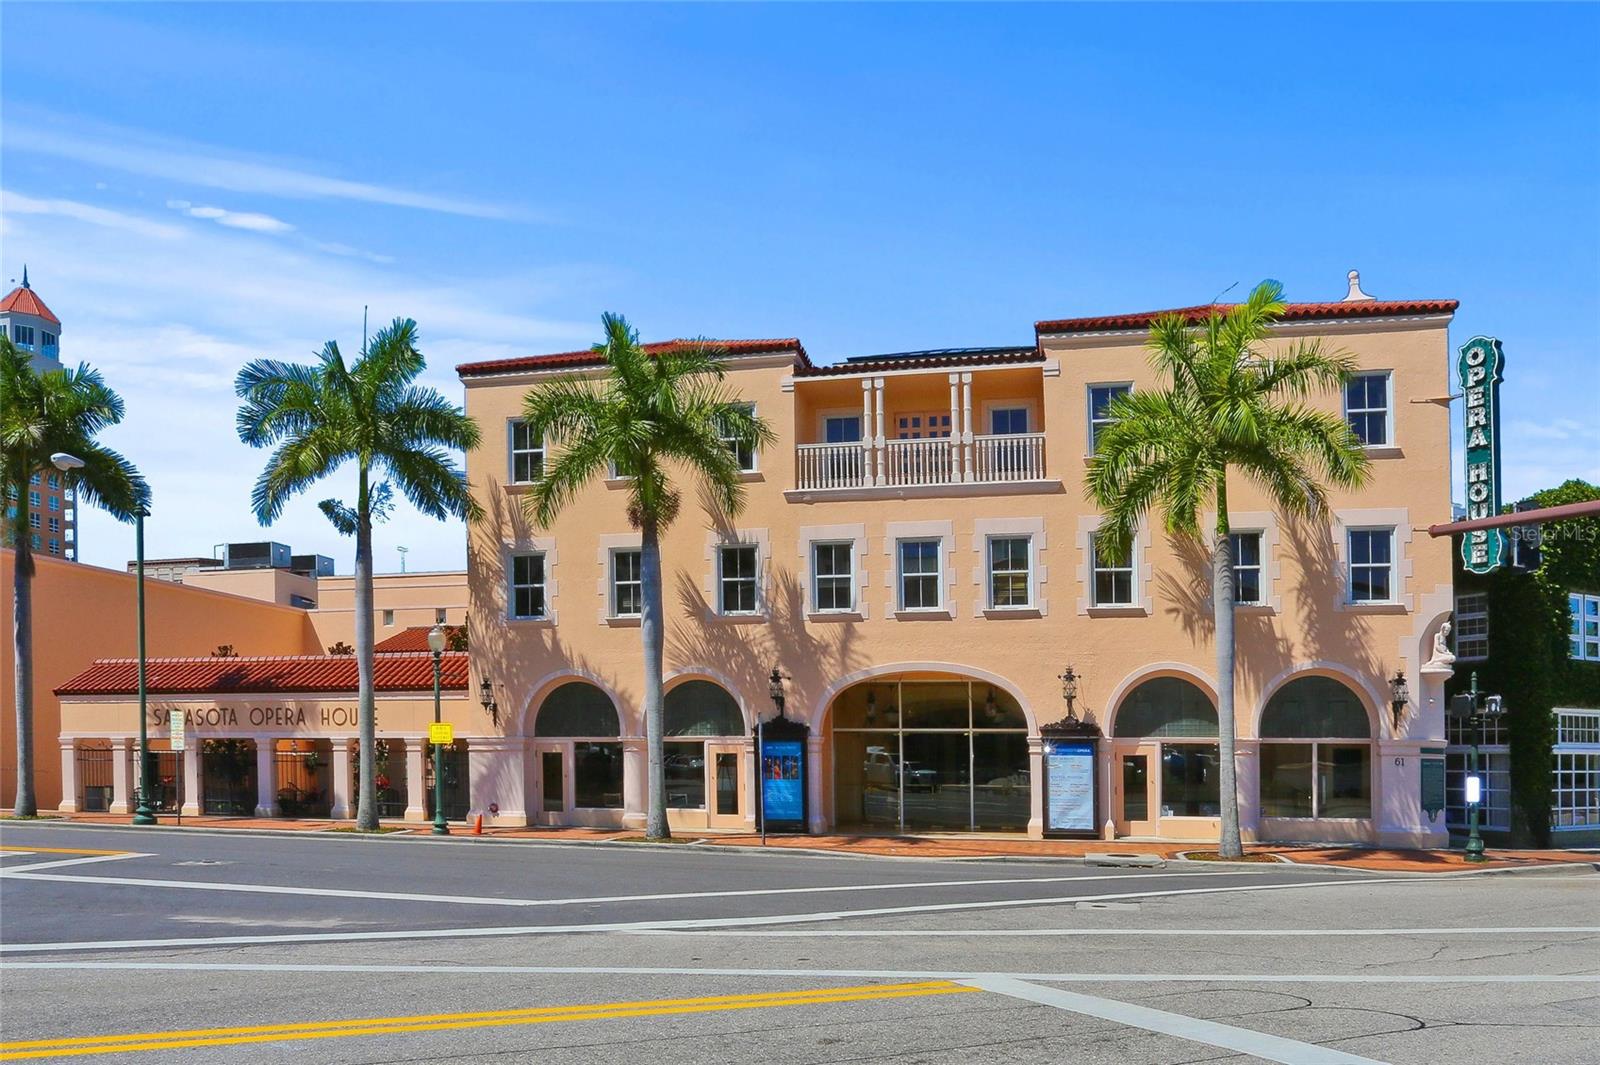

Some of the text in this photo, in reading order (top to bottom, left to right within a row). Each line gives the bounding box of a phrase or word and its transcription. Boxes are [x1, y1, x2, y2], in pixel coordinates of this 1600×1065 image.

[1465, 345, 1488, 449] OPERA
[153, 707, 379, 726] SAASOTA OPERA HOU
[1394, 757, 1405, 767] 61
